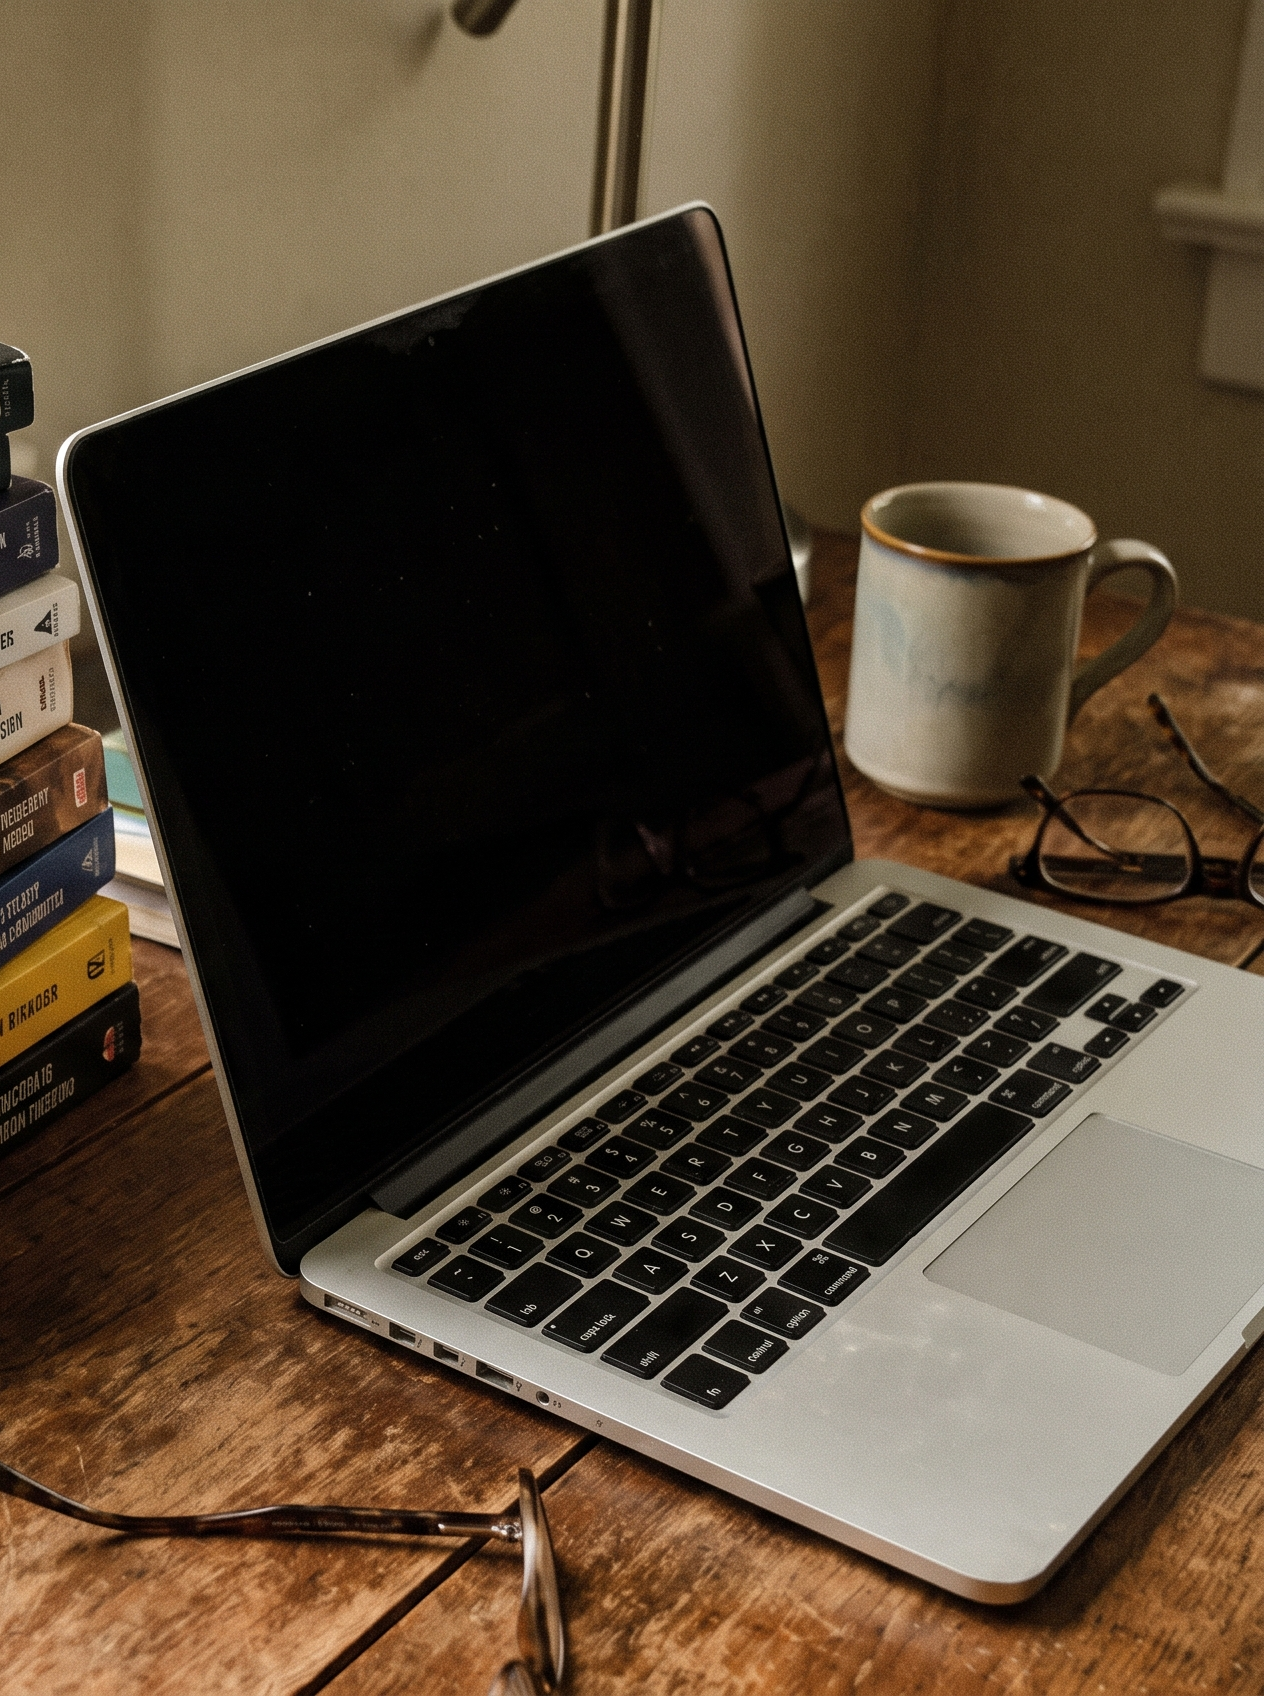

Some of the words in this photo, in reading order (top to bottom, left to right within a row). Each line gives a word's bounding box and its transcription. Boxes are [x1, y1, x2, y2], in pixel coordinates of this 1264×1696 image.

[856, 1024, 872, 1033] O
[886, 1062, 904, 1072] K
[730, 1072, 744, 1080] 7
[791, 1074, 807, 1084] U
[856, 1089, 868, 1097] J
[698, 1098, 710, 1106] 6
[925, 1094, 945, 1105] M
[757, 1102, 772, 1110] Y
[819, 1115, 837, 1126] H
[660, 1126, 674, 1135] 5
[893, 1122, 912, 1132] N
[723, 1128, 739, 1137] T
[788, 1143, 804, 1154] G
[625, 1154, 638, 1163] 4
[860, 1151, 877, 1161] B
[688, 1157, 705, 1167] R
[752, 1172, 767, 1182] F
[586, 1184, 601, 1193] 3
[826, 1179, 843, 1191] V
[651, 1187, 668, 1196] E
[717, 1202, 733, 1212] D
[548, 1213, 563, 1224] 2
[793, 1209, 811, 1219] C
[610, 1214, 632, 1228] W
[681, 1232, 697, 1242] S
[507, 1245, 522, 1253] 1
[756, 1240, 776, 1252] X
[575, 1248, 594, 1259] Q
[643, 1263, 661, 1275] A
[719, 1271, 738, 1283] Z
